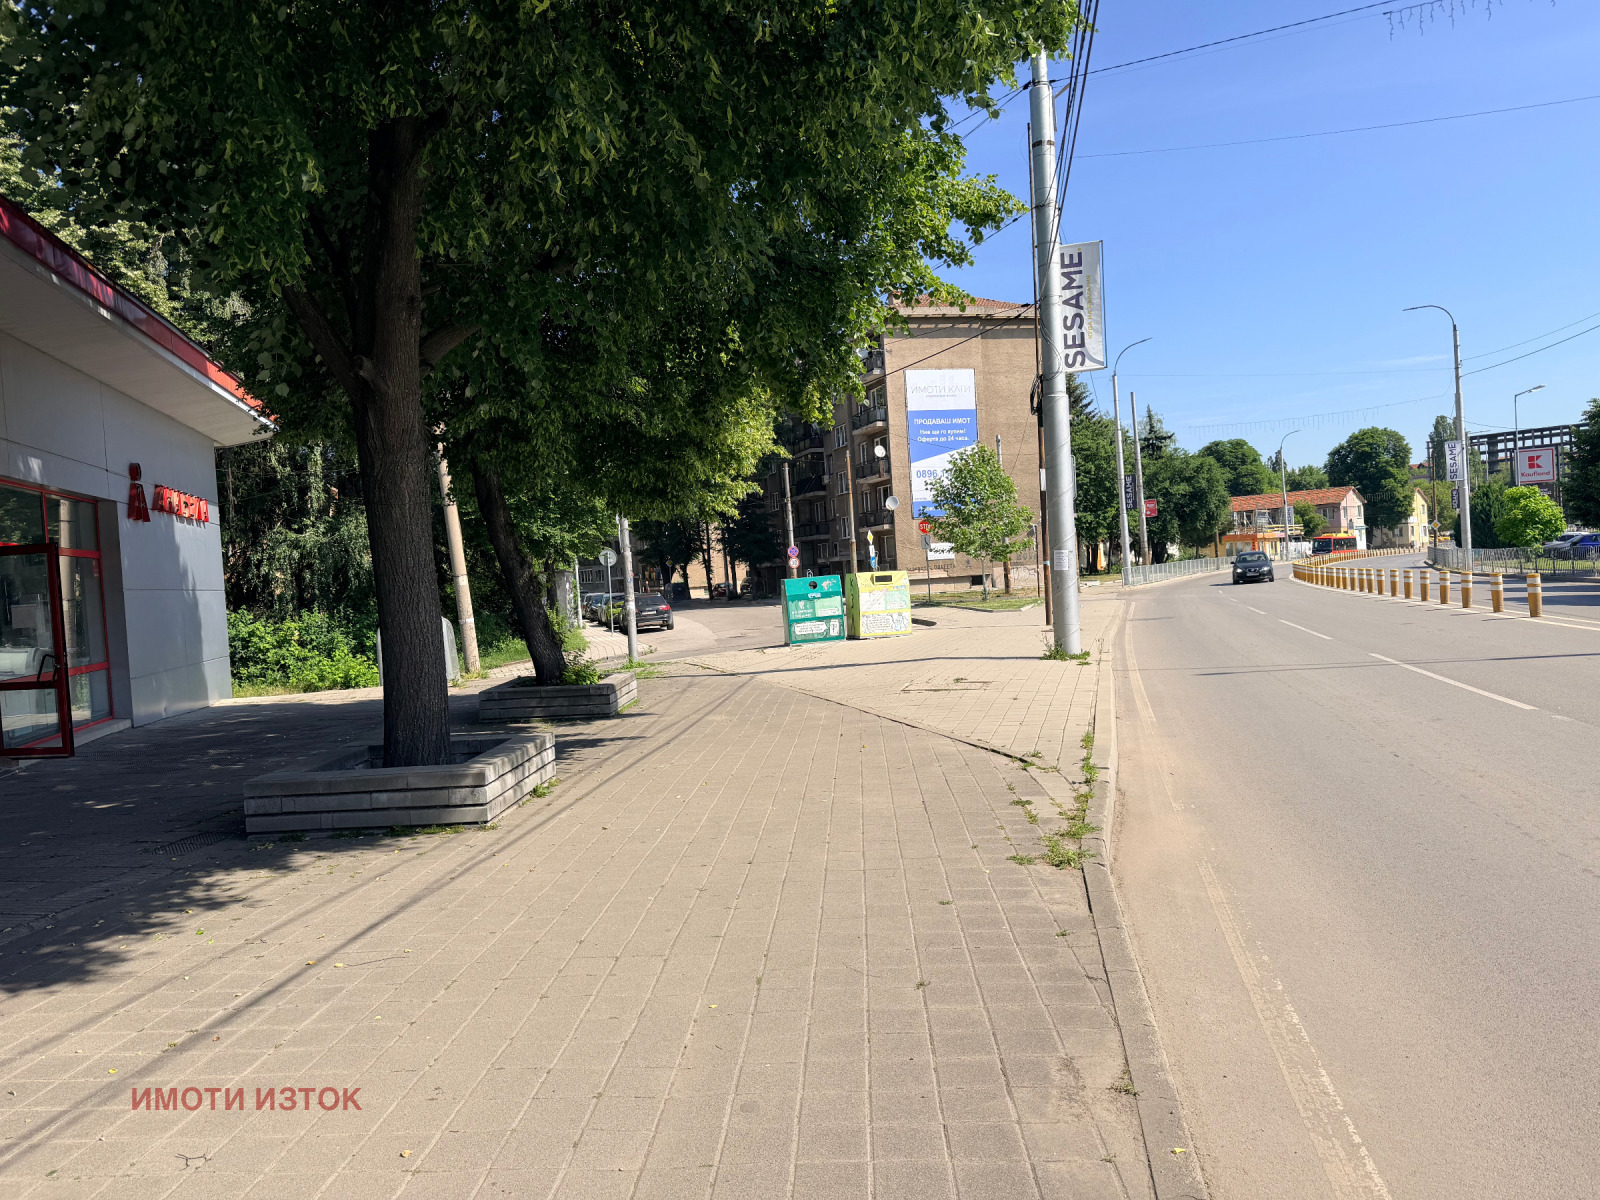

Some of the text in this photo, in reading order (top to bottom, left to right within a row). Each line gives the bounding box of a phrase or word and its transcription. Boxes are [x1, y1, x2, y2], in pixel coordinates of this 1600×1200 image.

[910, 385, 946, 394] ИМОТИ
[1448, 443, 1458, 480] SESAME
[916, 469, 938, 478] 0896
[1125, 475, 1134, 509] SESAME
